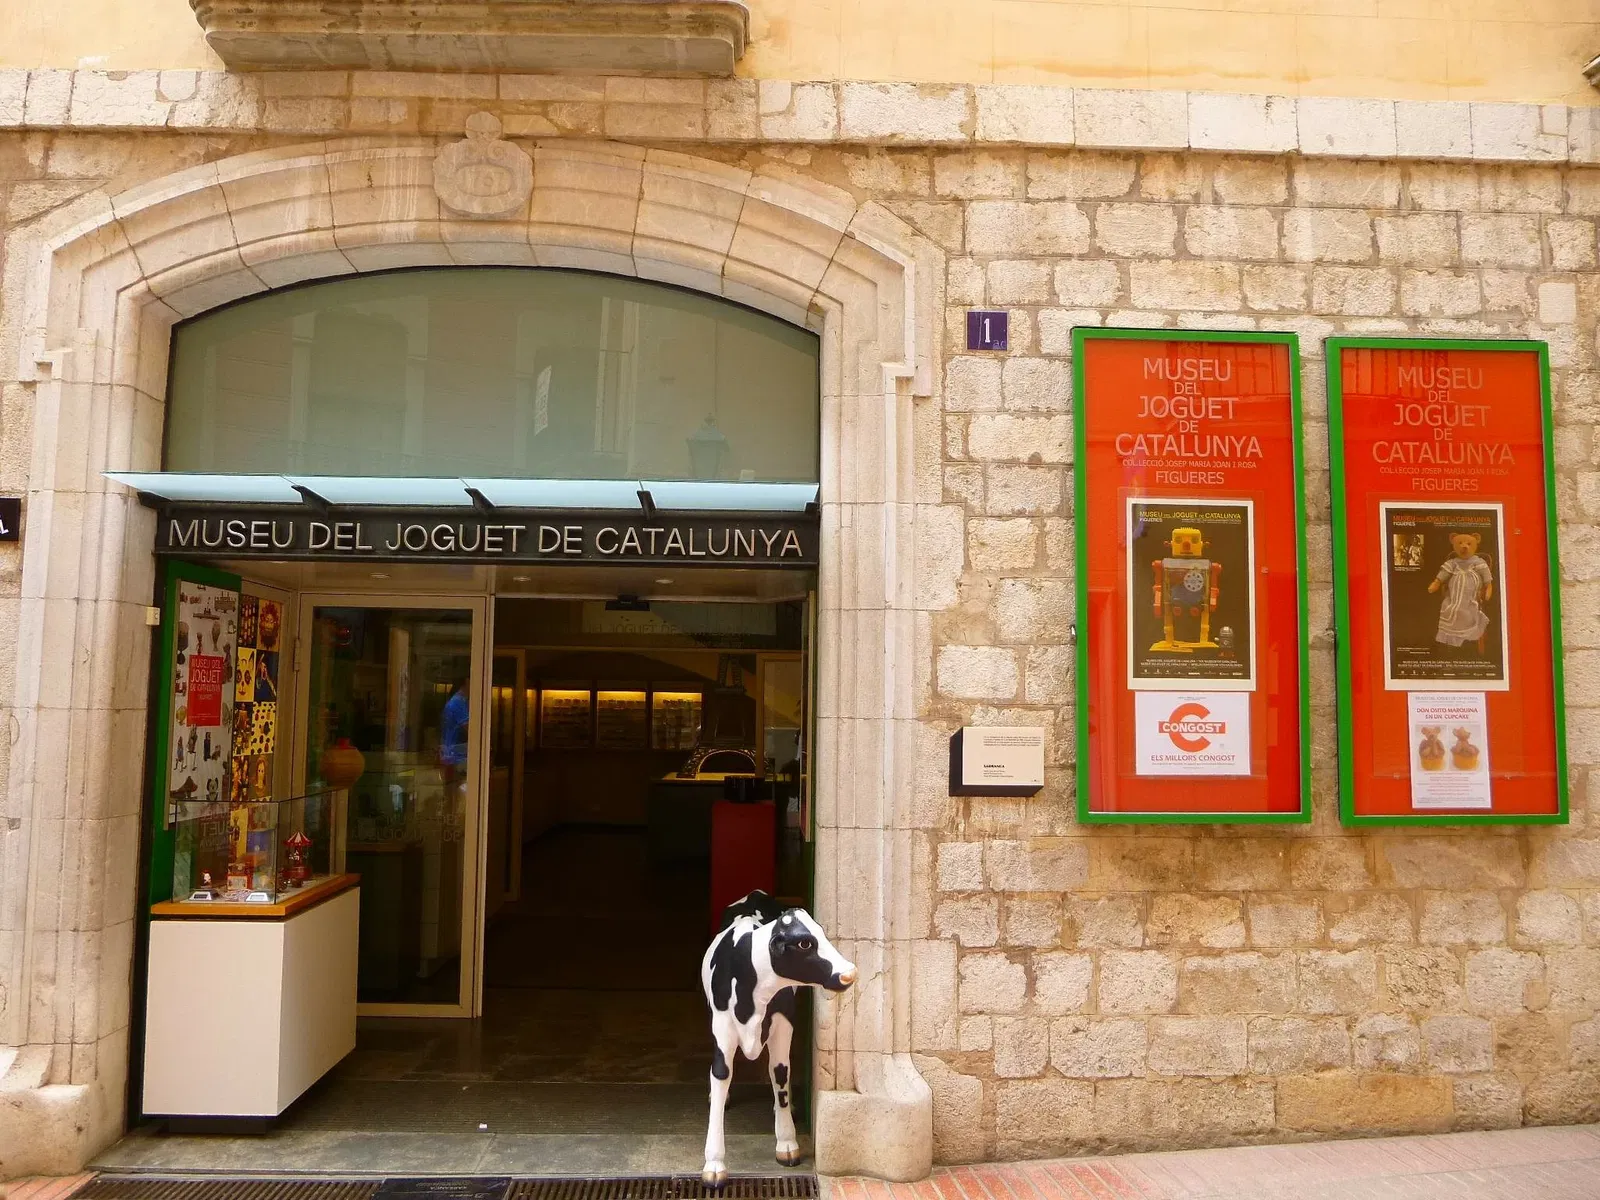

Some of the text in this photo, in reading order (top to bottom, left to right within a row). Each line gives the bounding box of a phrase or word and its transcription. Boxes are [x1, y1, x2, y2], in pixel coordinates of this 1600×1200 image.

[984, 318, 991, 343] 1
[1143, 357, 1231, 382] MUSEU
[1398, 366, 1483, 389] MUSEU
[1174, 382, 1201, 395] DEL
[1428, 391, 1455, 403] DEL
[1138, 396, 1239, 419] JOGUET
[1393, 404, 1491, 427] JOGUET
[1179, 421, 1199, 433] DE
[1434, 428, 1453, 441] DE
[1115, 433, 1263, 458] CATALUNYA
[1372, 441, 1515, 465] CATALUNYA
[1155, 471, 1225, 485] FIGUERES
[1411, 478, 1479, 491] FIGUERES
[168, 519, 803, 557] MUSEU DEL JOGUET DE CATALUNYA
[1162, 722, 1222, 733] CONGOST
[1151, 754, 1236, 762] ELS MILLORS CONGOST
